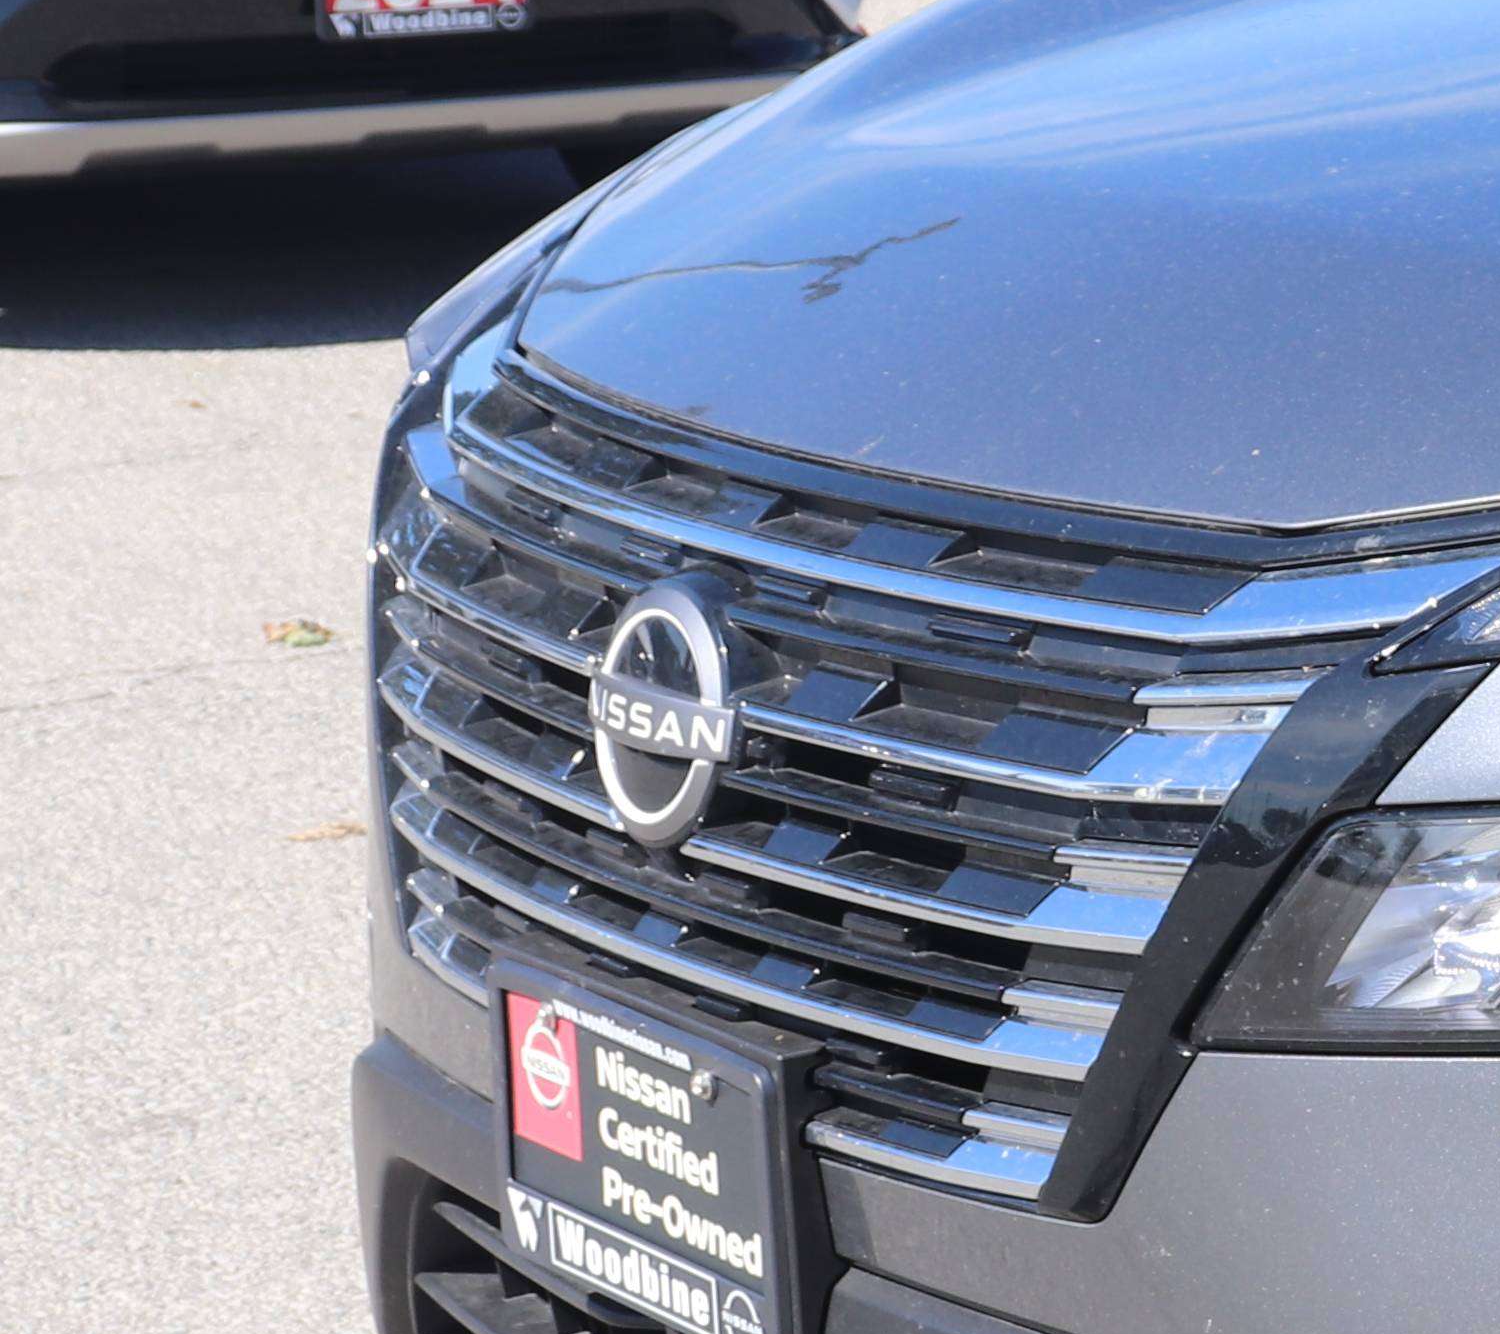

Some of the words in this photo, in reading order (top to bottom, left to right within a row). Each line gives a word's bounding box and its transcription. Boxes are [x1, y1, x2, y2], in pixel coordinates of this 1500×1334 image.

[370, 8, 489, 31] Woodbine
[595, 1046, 692, 1124] Nissan
[599, 1107, 720, 1196] Certified
[601, 1165, 764, 1278] Pre-Owned
[555, 1214, 711, 1327] Woodbine
